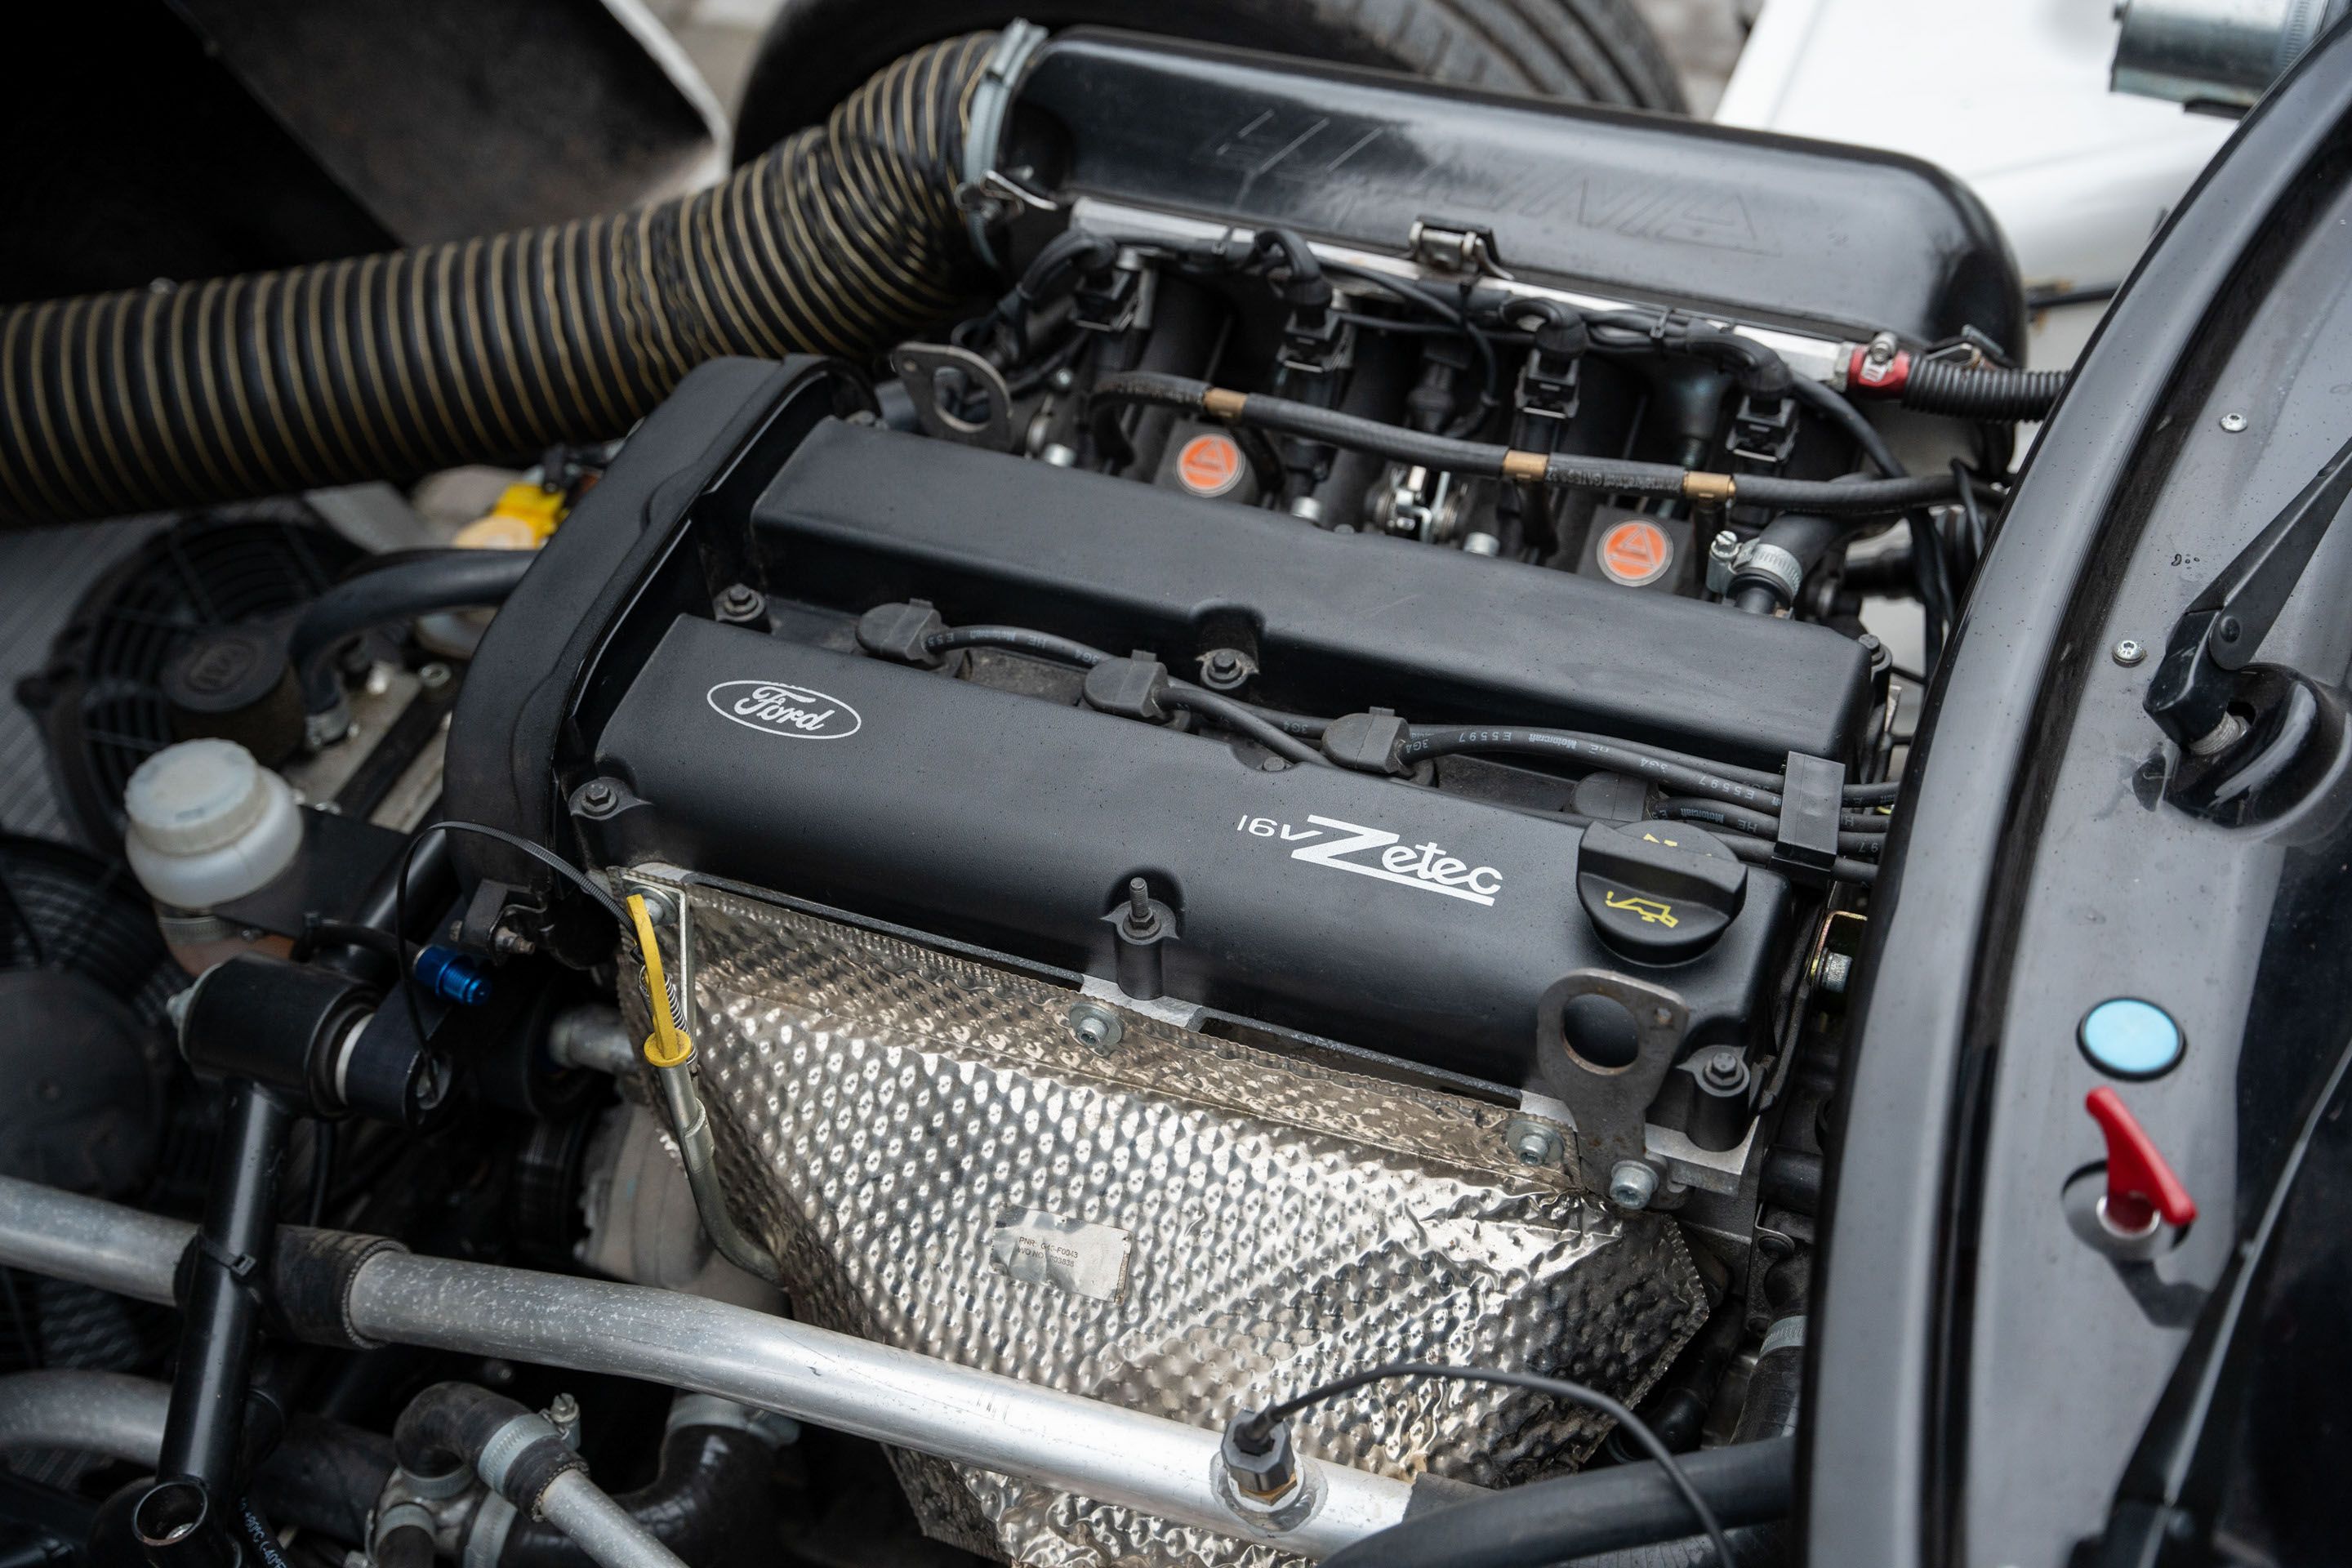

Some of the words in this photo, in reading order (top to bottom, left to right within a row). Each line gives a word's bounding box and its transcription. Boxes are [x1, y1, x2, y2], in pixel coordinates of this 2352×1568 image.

[734, 686, 835, 731] Ford
[1528, 733, 1578, 750] Motorcraft
[1680, 808, 1725, 824] Motorcraft
[1290, 814, 1503, 906] Zetec
